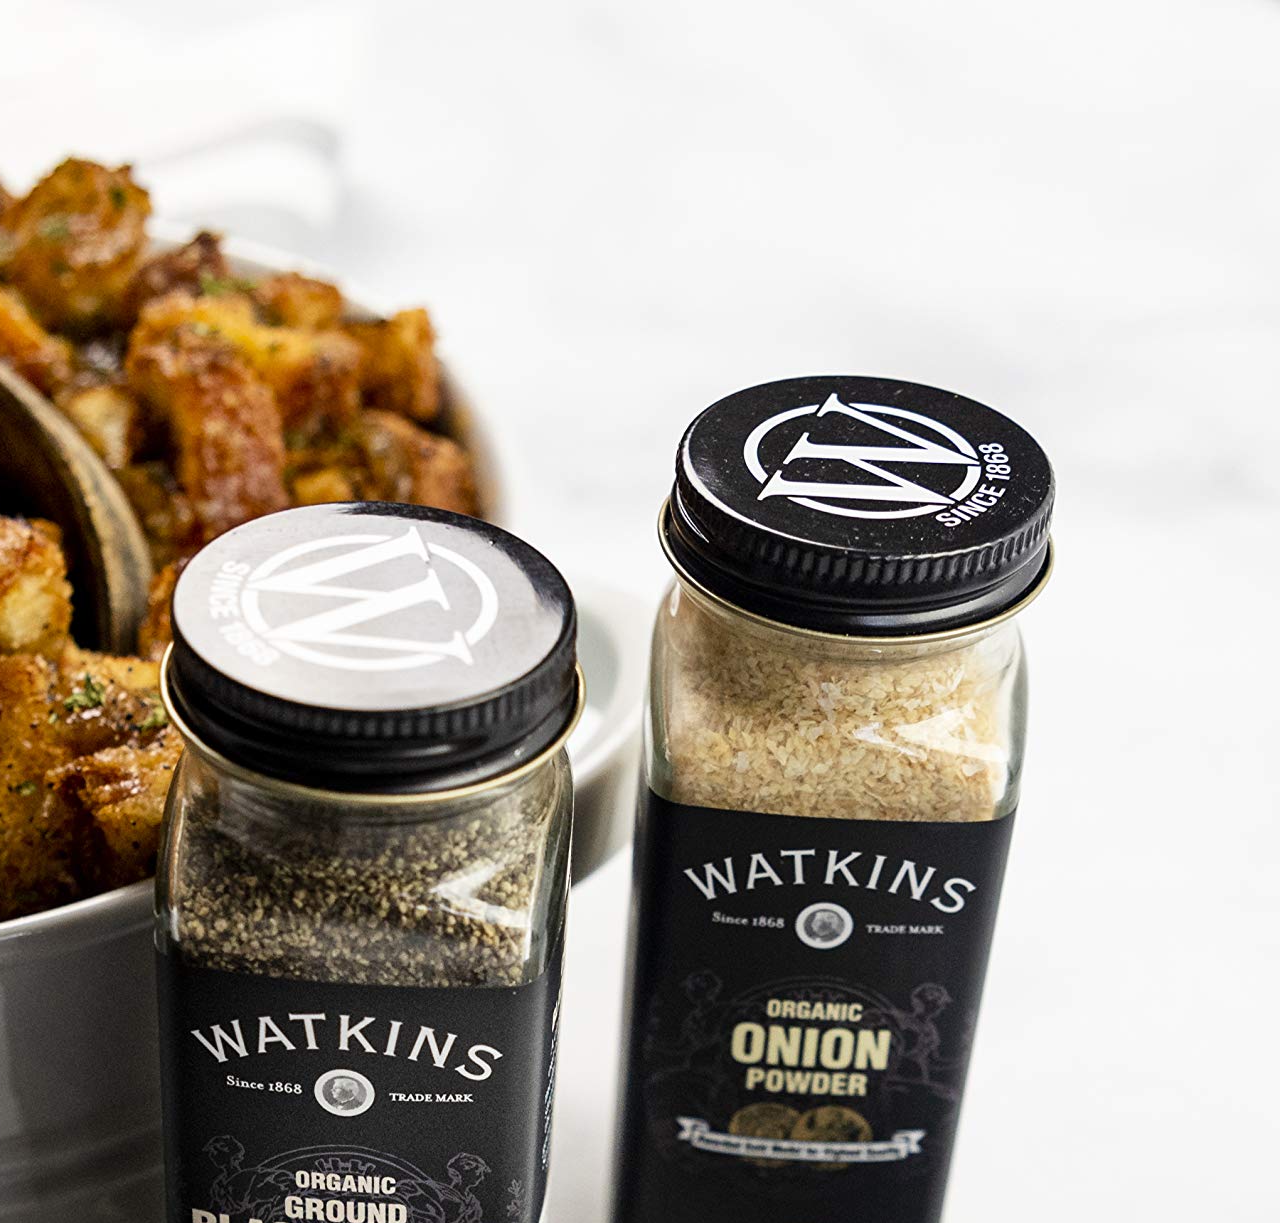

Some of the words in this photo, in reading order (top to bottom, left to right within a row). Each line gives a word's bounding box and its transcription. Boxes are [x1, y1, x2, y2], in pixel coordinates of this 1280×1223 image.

[935, 483, 1007, 528] SINCE
[978, 442, 1012, 481] 1868
[208, 560, 252, 620] SINCE
[683, 848, 978, 914] WATKINS
[711, 911, 749, 926] Since
[751, 914, 786, 929] 1868
[865, 924, 906, 935] TRADE
[908, 924, 945, 935] MARK
[766, 998, 864, 1023] ORGANIC
[190, 1012, 504, 1081] WATKINS
[730, 1021, 892, 1071] ONION
[226, 1075, 265, 1091] Since
[268, 1081, 304, 1095] 1868
[745, 1066, 868, 1097] POWDER
[388, 1092, 432, 1103] TRADE
[434, 1093, 475, 1104] MARK
[294, 1169, 397, 1196] ORGANIC
